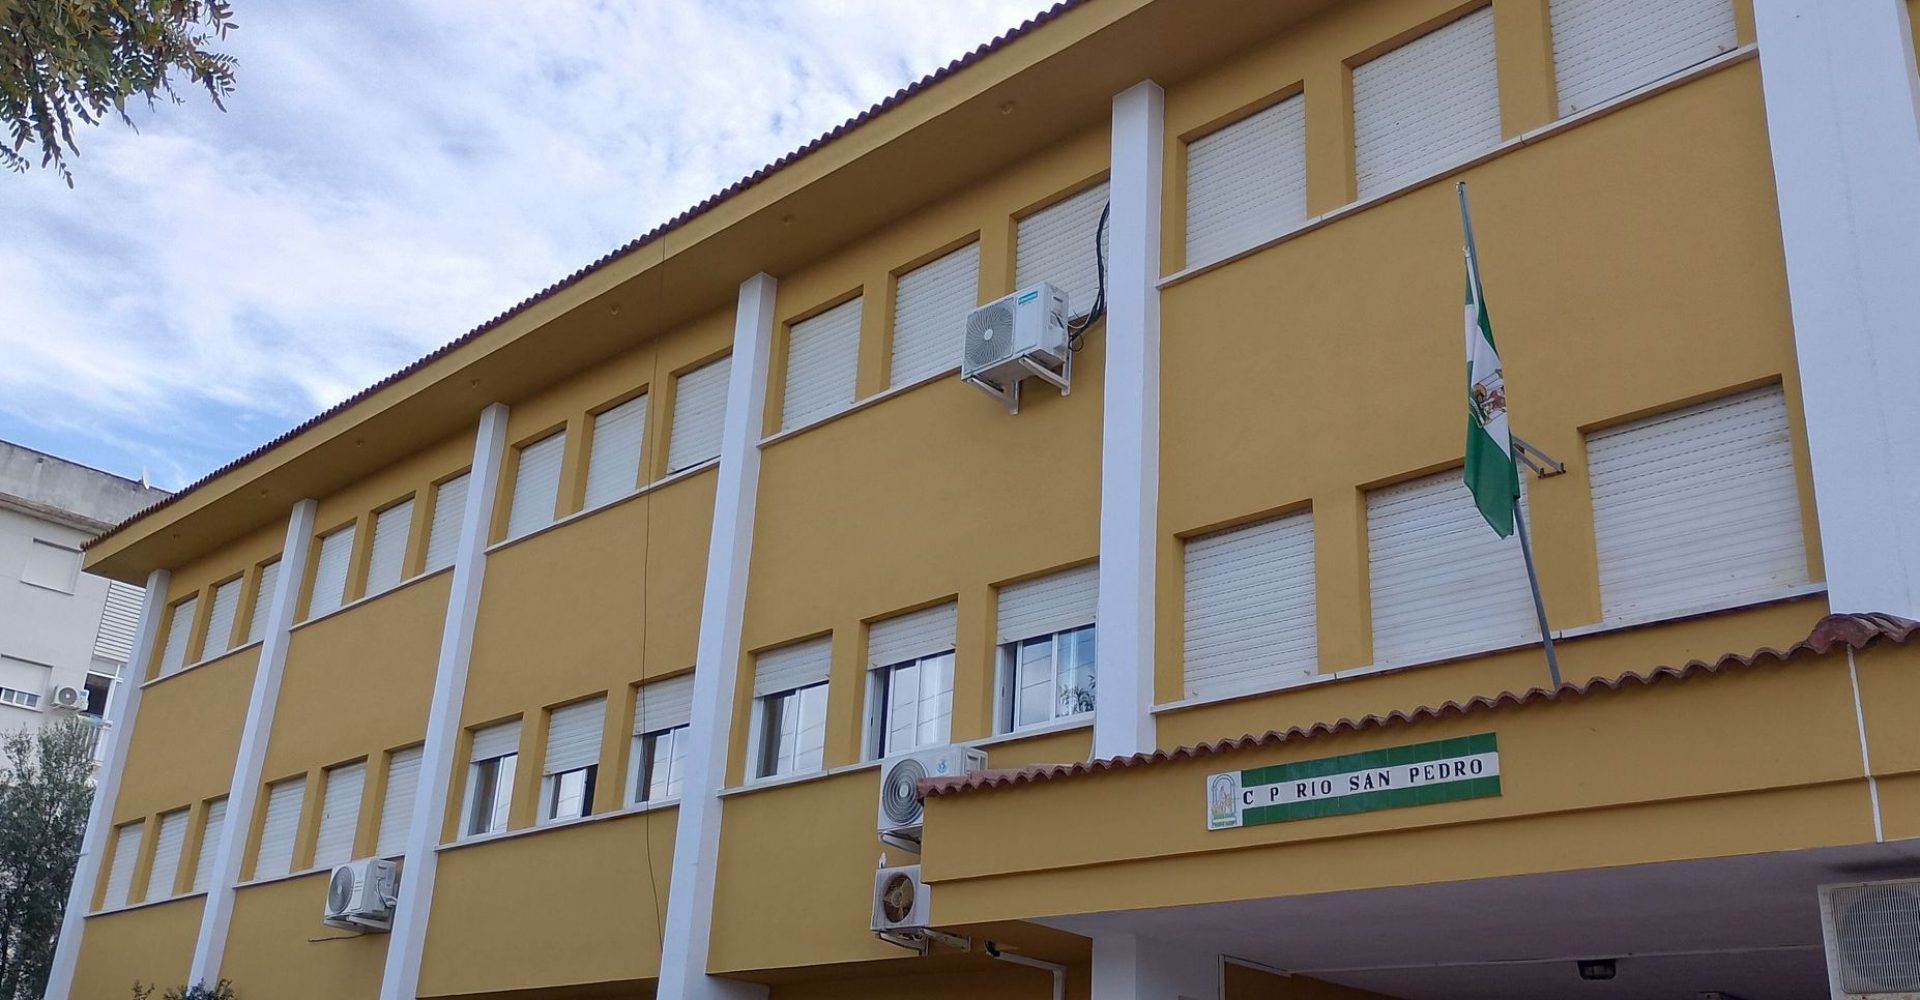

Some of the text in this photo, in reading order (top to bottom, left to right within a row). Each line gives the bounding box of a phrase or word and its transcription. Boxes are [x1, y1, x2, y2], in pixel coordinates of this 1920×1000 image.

[1243, 758, 1483, 805] C P RIO SAN PEDRO
